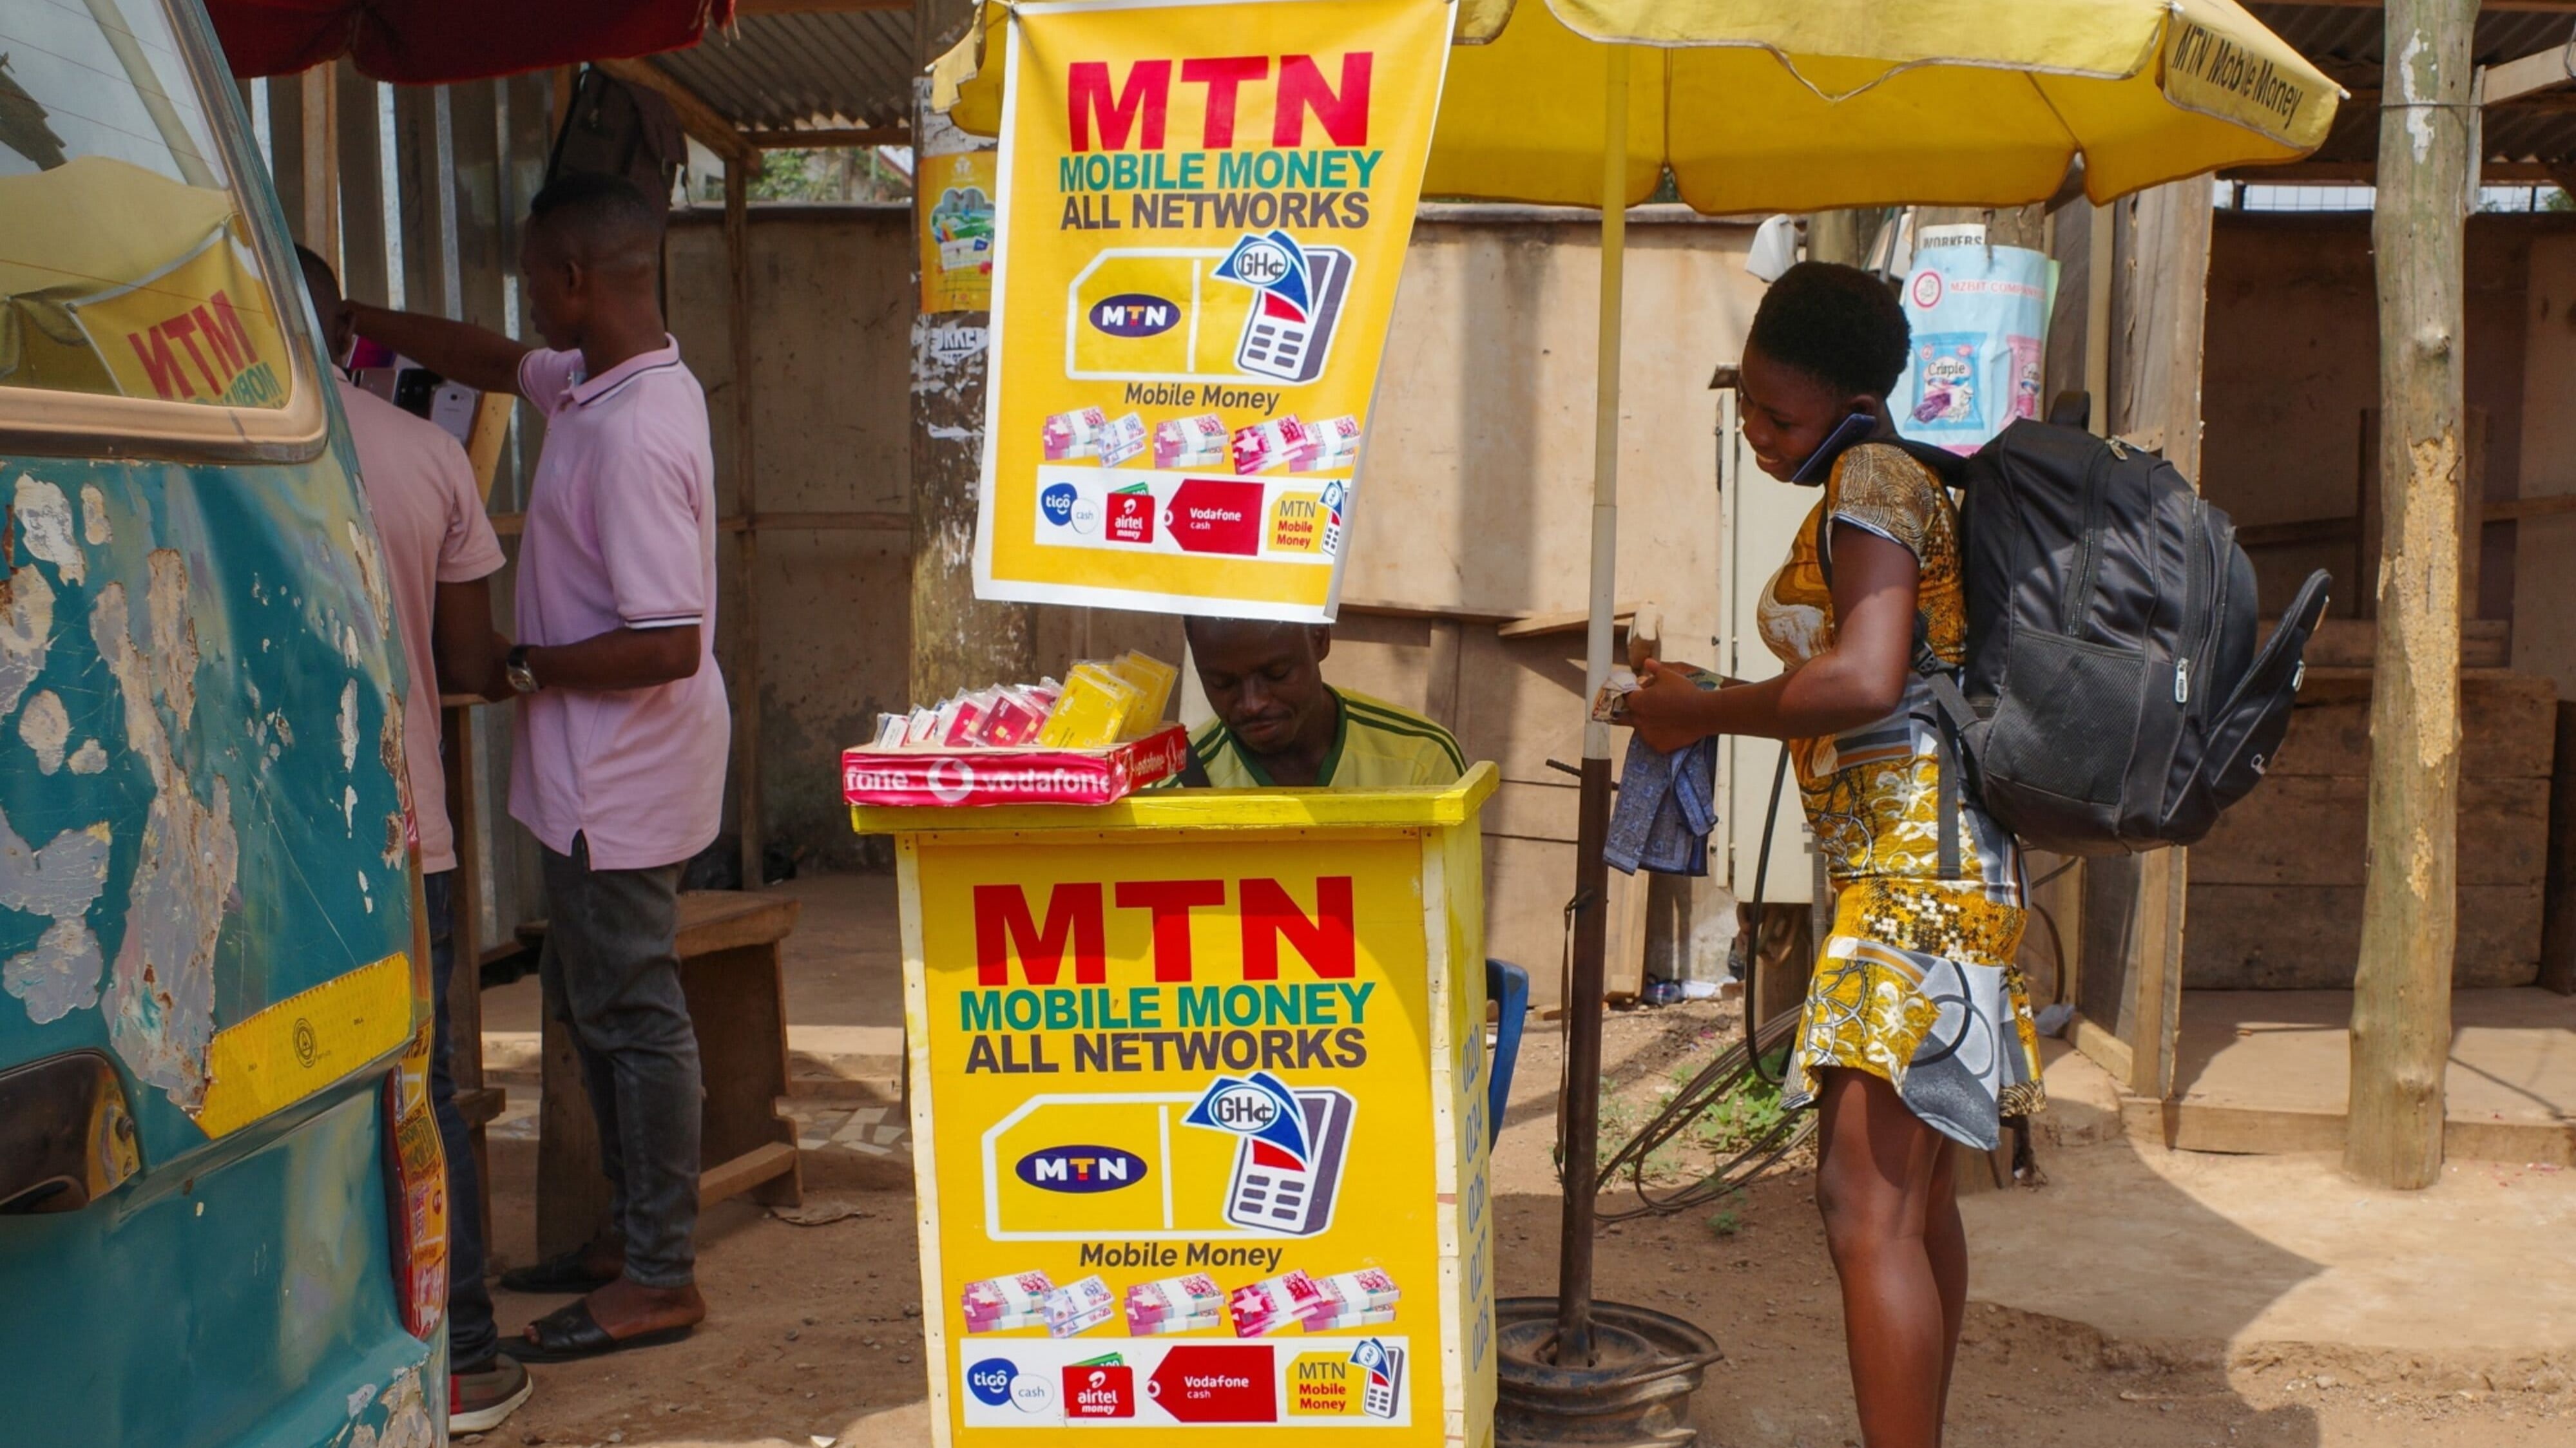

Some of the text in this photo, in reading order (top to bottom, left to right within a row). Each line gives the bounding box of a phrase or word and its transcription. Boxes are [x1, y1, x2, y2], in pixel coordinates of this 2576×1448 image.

[2172, 23, 2303, 129] MTN Mobile Money
[1068, 52, 1373, 152] MTN
[1059, 150, 1383, 192] MOBILE MONEY
[1060, 192, 1369, 231] ALL NETWORKS
[1102, 305, 1167, 327] MTN
[1124, 383, 1280, 415] Mobile Money
[1076, 511, 1093, 520] cash
[1189, 508, 1242, 521] Vodafone
[1280, 500, 1316, 518] MTN
[1115, 515, 1142, 529] airtel
[1190, 521, 1211, 530] cash
[1278, 520, 1313, 533] Mobile
[1117, 529, 1140, 540] money
[1276, 534, 1311, 549] Money
[846, 766, 1110, 794] fone vodafone
[973, 876, 1355, 986] MTN
[961, 982, 1376, 1031] MOBILE MONEY
[965, 1027, 1367, 1074] ALL NETWORKS
[1463, 1024, 1480, 1093] 020
[1466, 1091, 1483, 1165] 024
[1035, 1158, 1128, 1181] MTN
[1468, 1158, 1485, 1234] 026
[1081, 1243, 1283, 1272] Mobile Money
[1470, 1225, 1486, 1303] 027
[1473, 1294, 1488, 1373] 028
[1184, 1375, 1249, 1388] Vodafone
[1299, 1362, 1346, 1379] MTN
[1019, 1387, 1044, 1397] cash
[1077, 1390, 1118, 1404] airtel
[1187, 1390, 1211, 1399] cash
[1299, 1384, 1346, 1395] Mobile
[1082, 1405, 1115, 1415] money
[1300, 1398, 1346, 1411] Money
